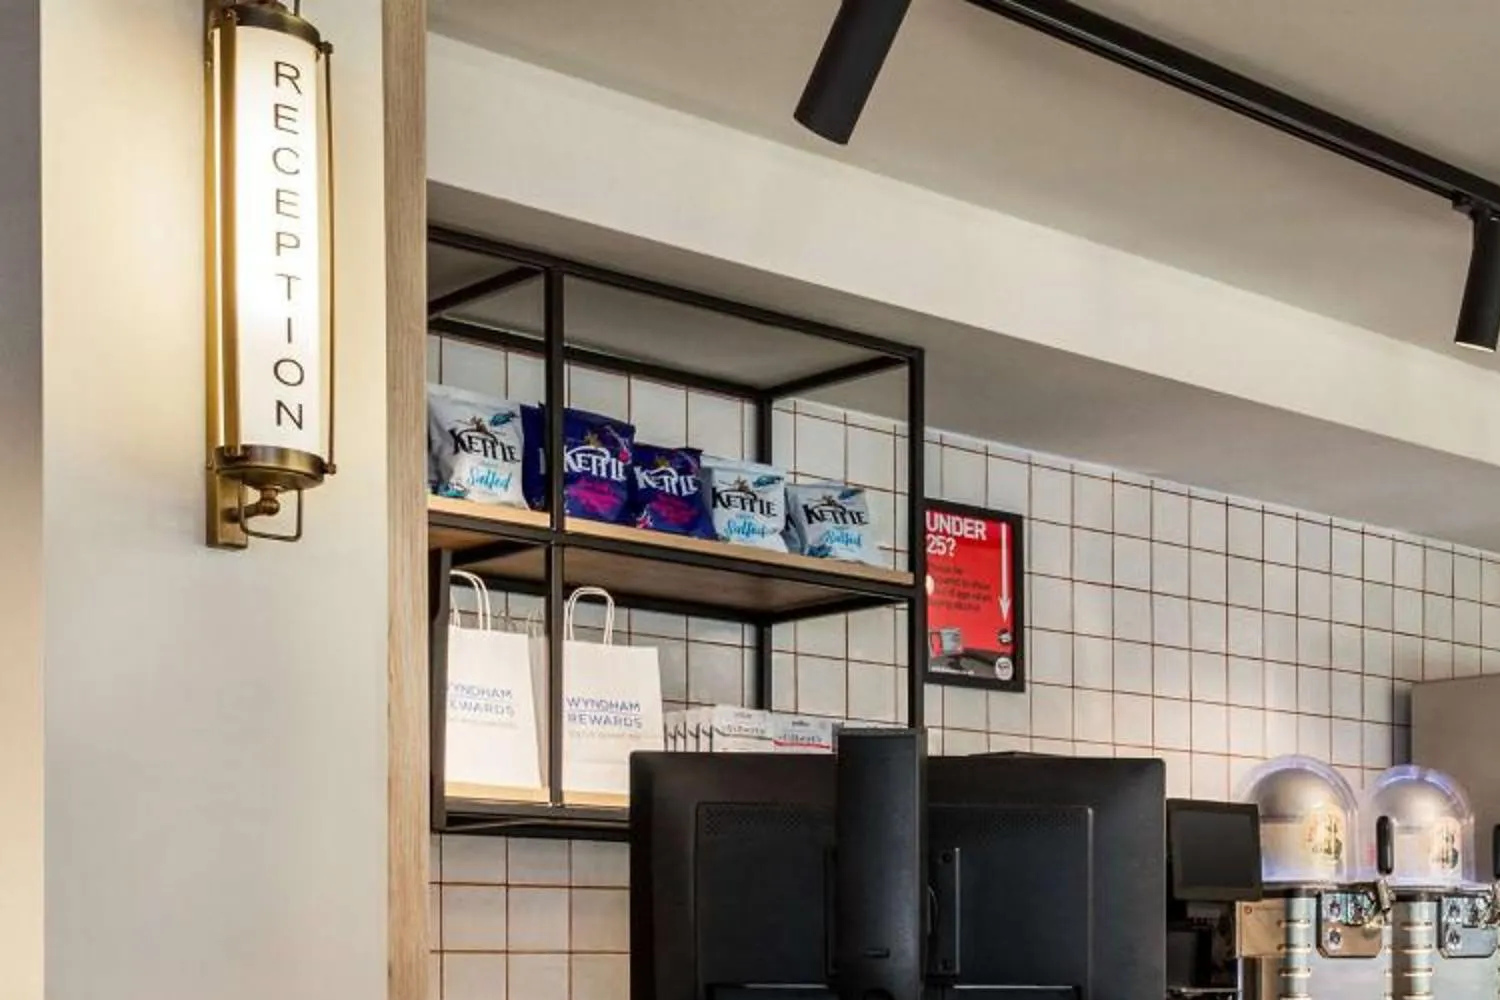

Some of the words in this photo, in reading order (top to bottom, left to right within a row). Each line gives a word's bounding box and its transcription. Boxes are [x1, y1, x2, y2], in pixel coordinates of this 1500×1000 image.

[272, 60, 305, 431] RECEPTION
[447, 427, 521, 463] KETTLE
[633, 465, 699, 497] KETTLE
[711, 487, 777, 518] KETTLE
[802, 503, 869, 525] KETTLE
[925, 510, 987, 541] UNDER
[926, 534, 957, 558] 25?
[450, 682, 513, 700] YNDHAM
[450, 701, 515, 718] EWARDS
[566, 697, 641, 713] WYNDHAM
[567, 712, 644, 729] REWARDS
